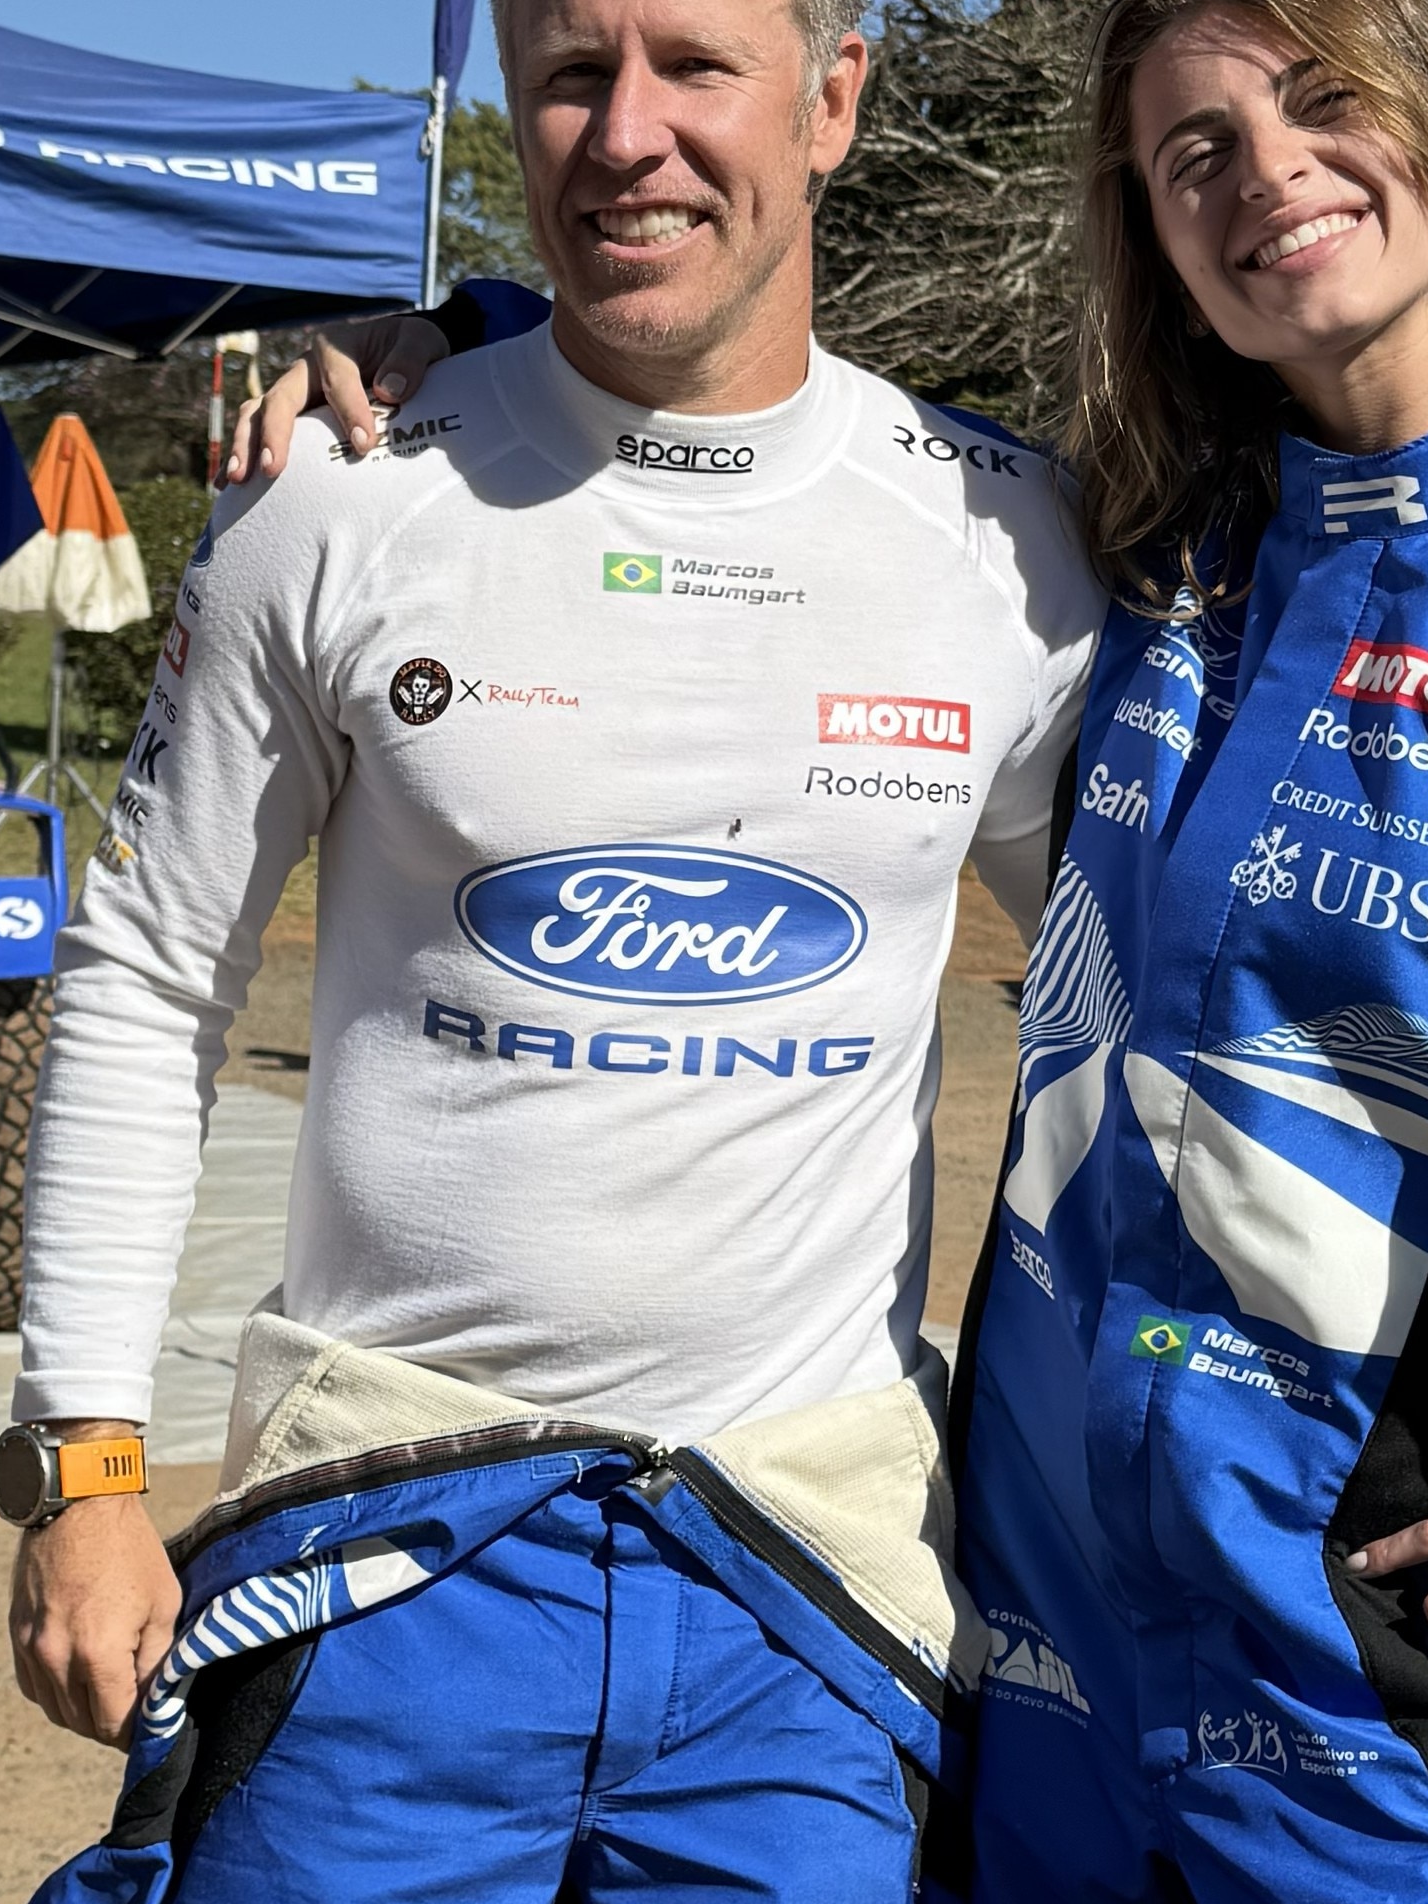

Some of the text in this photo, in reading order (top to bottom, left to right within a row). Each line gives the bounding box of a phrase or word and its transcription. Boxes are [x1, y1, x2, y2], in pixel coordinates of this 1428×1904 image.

[615, 433, 755, 474] sparco
[892, 424, 1022, 479] ROCK
[671, 558, 775, 580] Marcos
[671, 580, 807, 606] Baumgart
[825, 702, 967, 746] MOTUL
[1113, 696, 1203, 762] webdiet
[803, 765, 973, 807] Rodobens
[1271, 780, 1356, 821] CREDIT
[530, 866, 790, 978] Ford
[423, 997, 875, 1079] RACING
[1201, 1328, 1311, 1377] Marcos
[1188, 1352, 1335, 1408] Baumgart
[1014, 1694, 1045, 1709] POVO
[1359, 1751, 1379, 1761] ao
